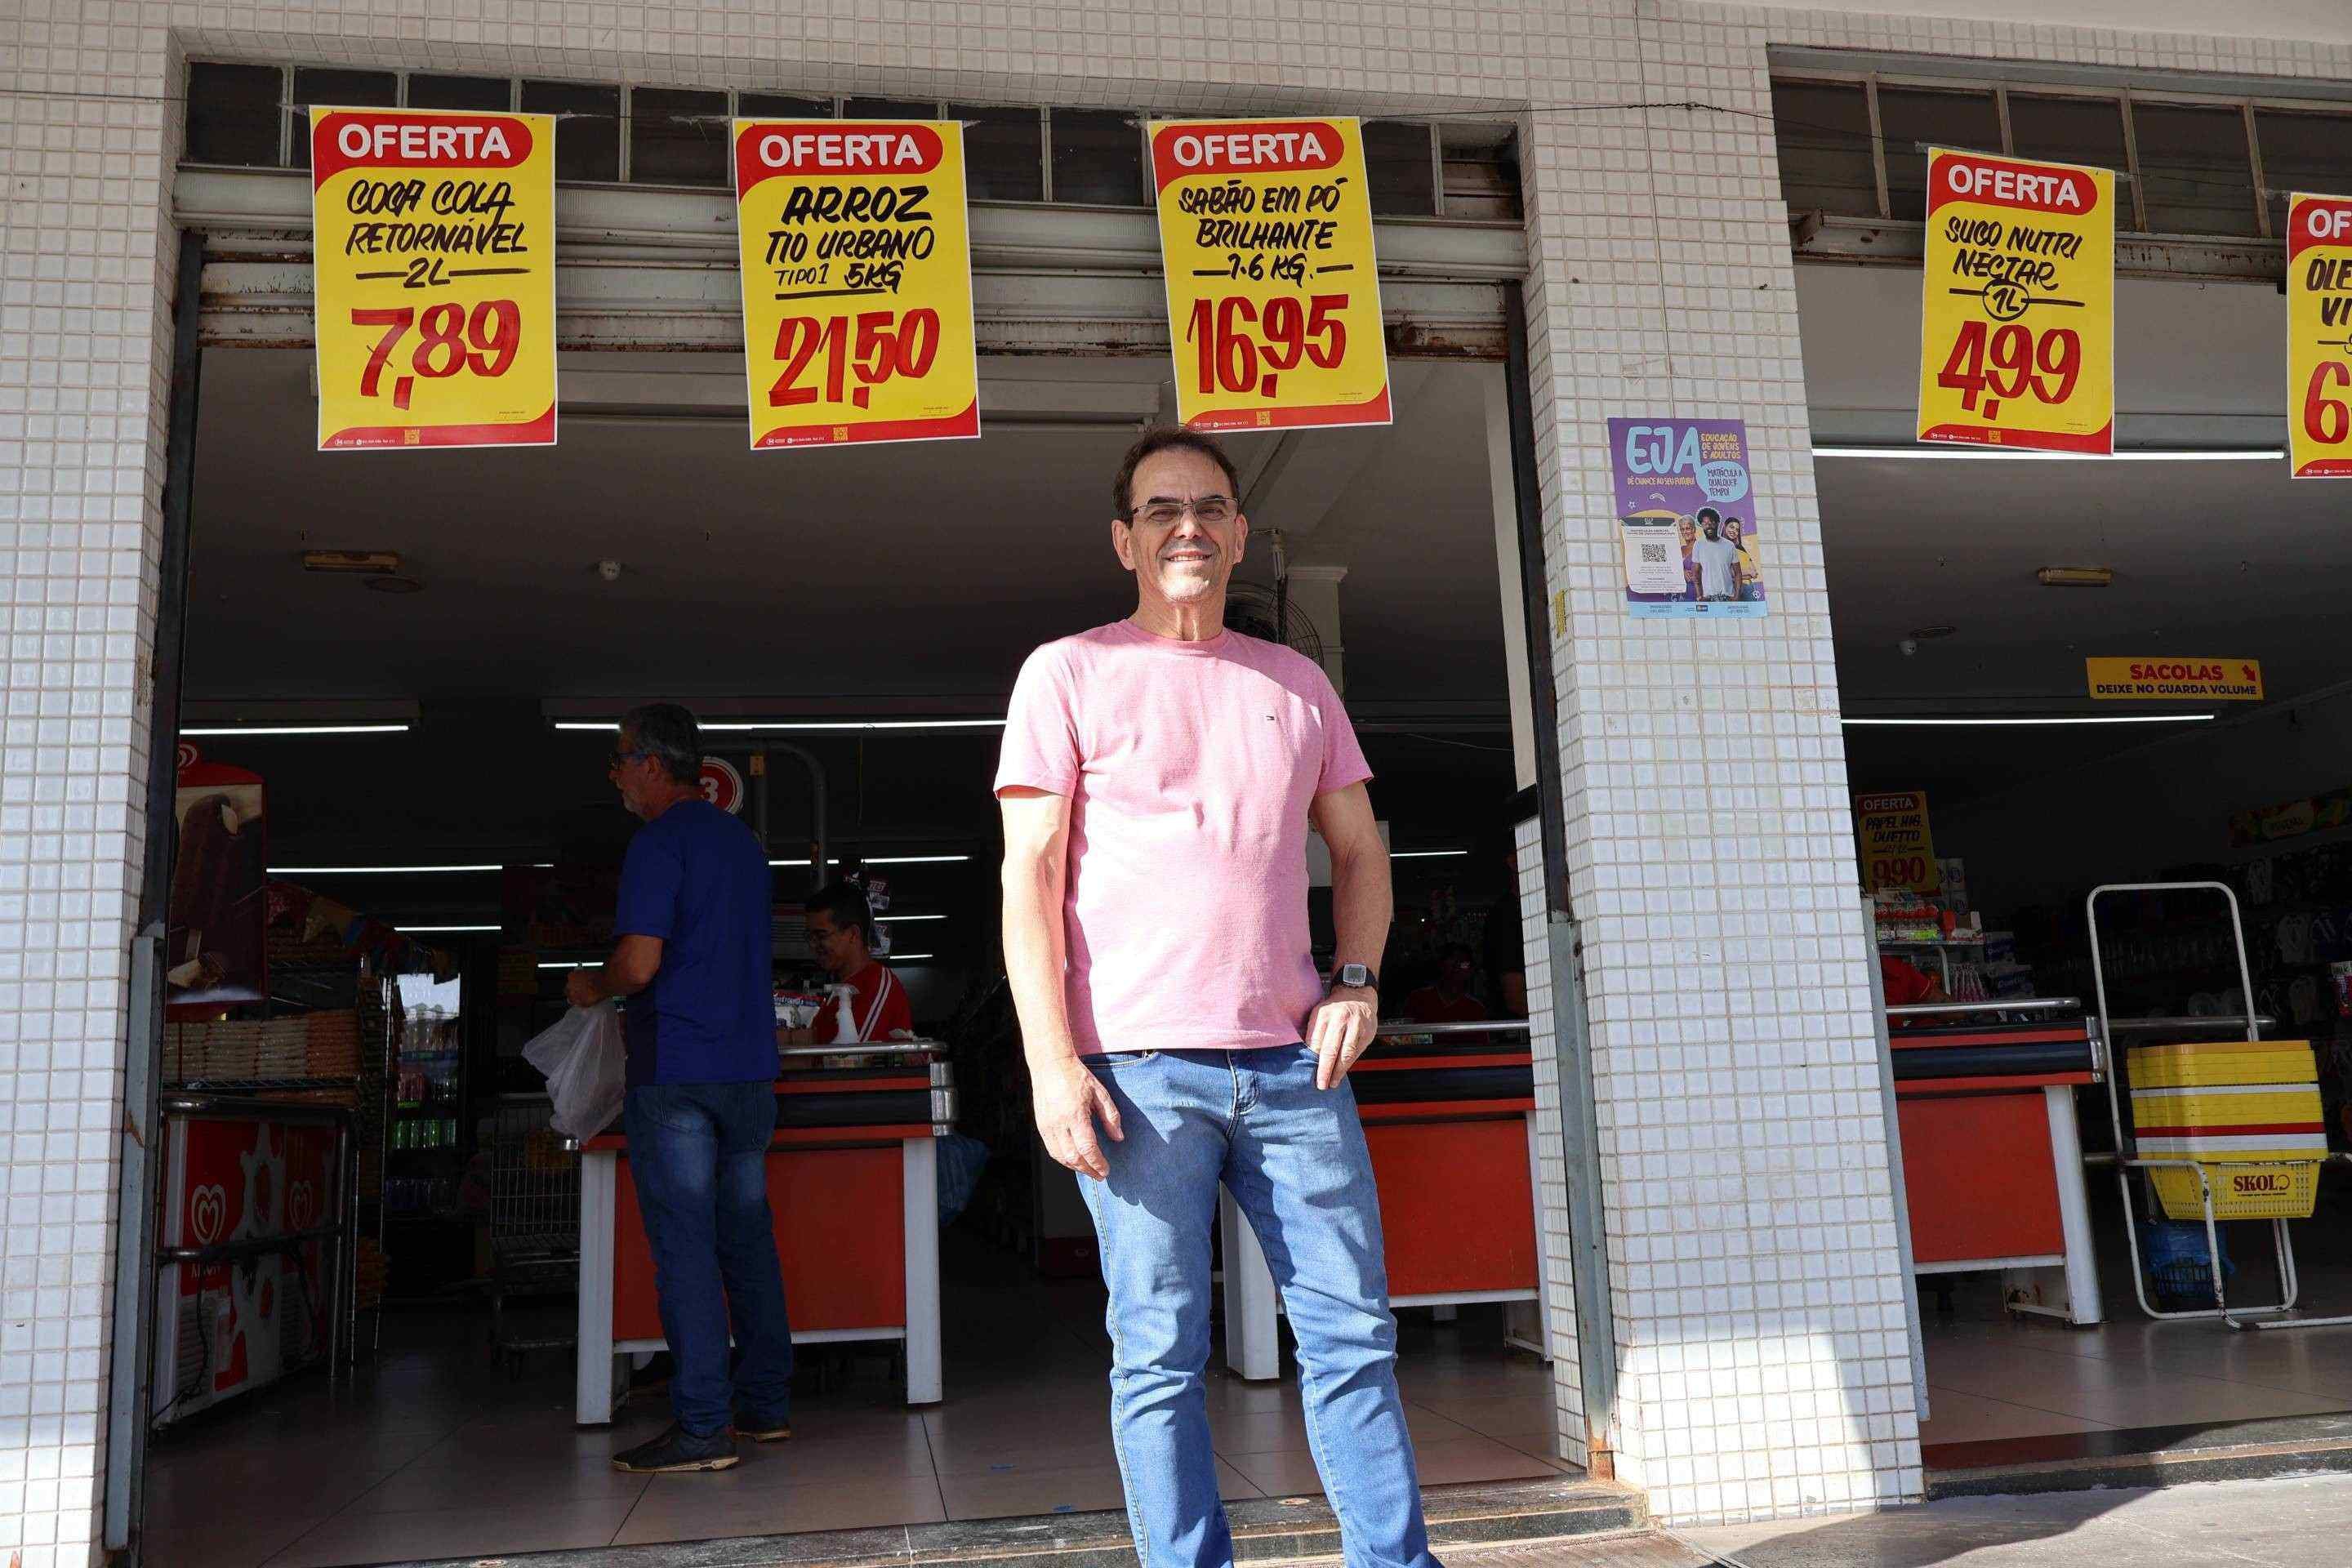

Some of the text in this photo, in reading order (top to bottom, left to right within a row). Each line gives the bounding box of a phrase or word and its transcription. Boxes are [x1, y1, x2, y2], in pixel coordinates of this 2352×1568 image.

[338, 123, 511, 160] OFERTA
[760, 135, 924, 167] OFERTA
[1173, 131, 1327, 167] OFERTA
[347, 178, 514, 229] COCA COLA
[1178, 176, 1349, 216] SABÃO EM PÓ
[1947, 163, 2082, 208] OFERTA
[781, 185, 934, 226] ARROZ
[345, 218, 528, 256] RETORNÁVEL
[765, 225, 935, 265] TIO URBANO
[1196, 217, 1339, 252] BRILHANTE
[1944, 215, 2084, 261] SUCO NUTRI
[403, 257, 451, 288] 2L
[844, 260, 905, 294] 5KG
[1952, 247, 2060, 291] NÉCTAR
[1992, 287, 2021, 314] 1L
[351, 299, 521, 411] 7,89
[768, 308, 940, 410] 21,50
[1186, 294, 1350, 399] 16,95
[1936, 319, 2082, 421] 4,99
[1626, 426, 1701, 474] EJA
[1701, 432, 1738, 443] EDUCAÇÃO
[1702, 442, 1740, 451] DE JOVENS
[1703, 451, 1742, 459] E ADULTOS
[2096, 684, 2257, 695] DEIXE NO GUARDA VOLUME
[2129, 664, 2225, 681] SACOLAS
[1864, 797, 1914, 811] OFERTA
[1866, 816, 1897, 831] PAPEL
[2234, 1174, 2278, 1192] SKOL
